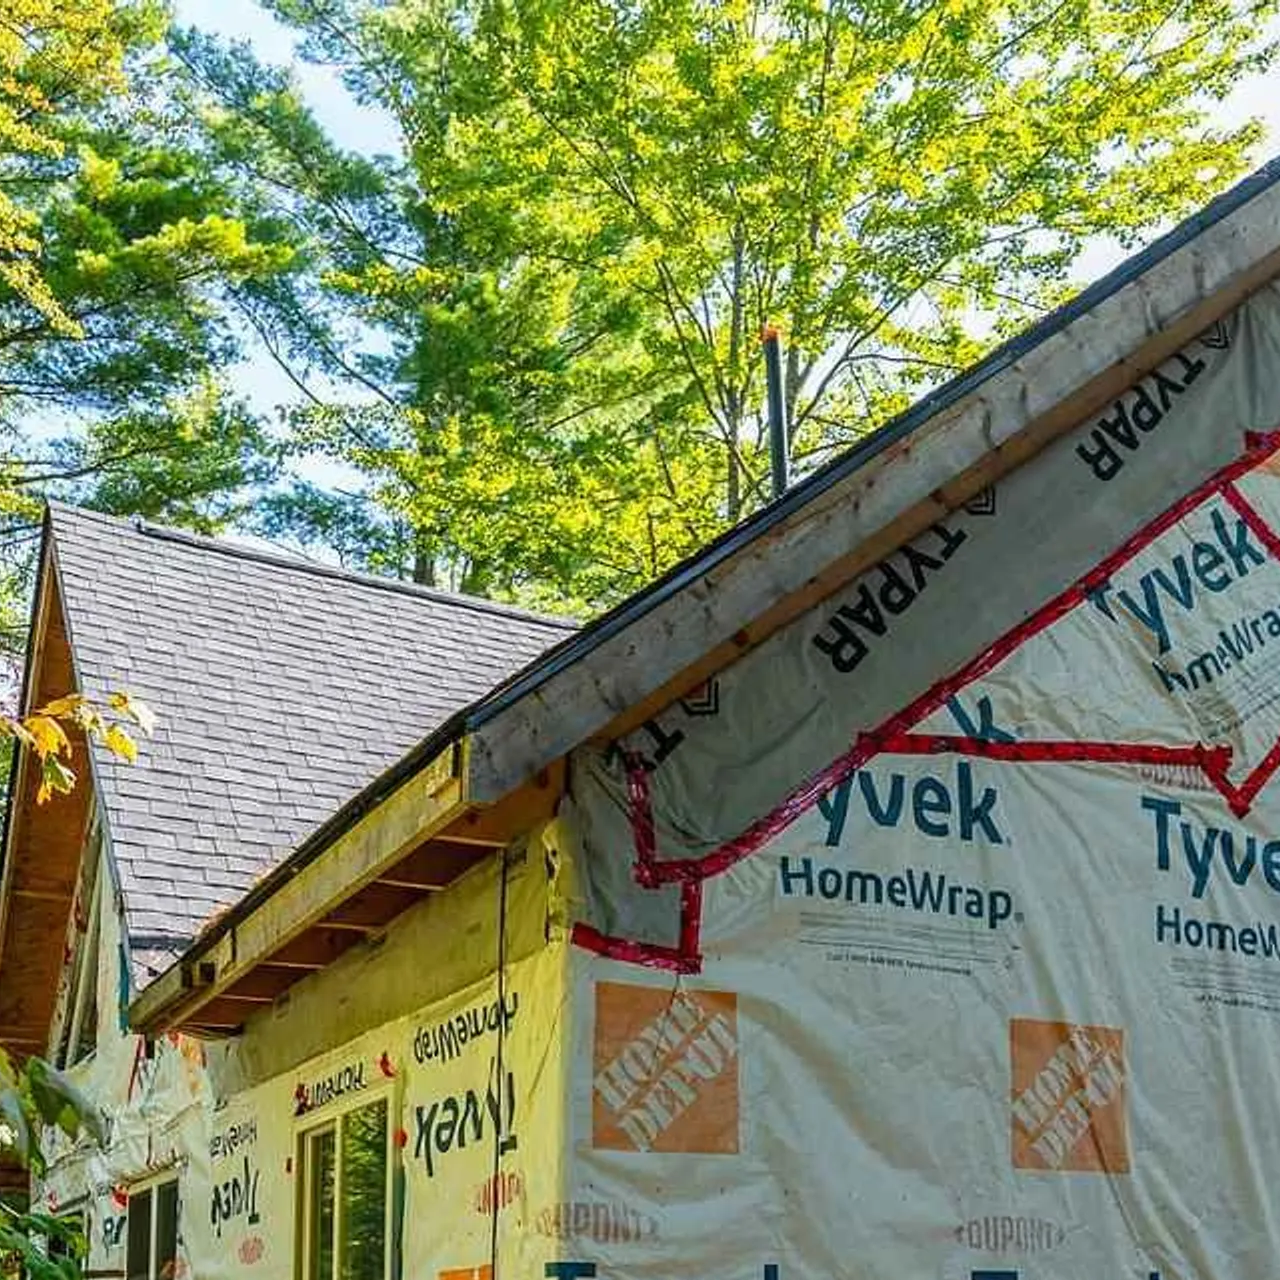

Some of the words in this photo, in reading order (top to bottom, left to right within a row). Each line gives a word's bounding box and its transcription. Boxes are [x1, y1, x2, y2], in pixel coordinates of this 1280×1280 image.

[1076, 344, 1207, 484] TYPAR
[810, 520, 970, 675] TYPAR
[818, 762, 1012, 847] yvek
[780, 856, 1013, 930] HomeWrap
